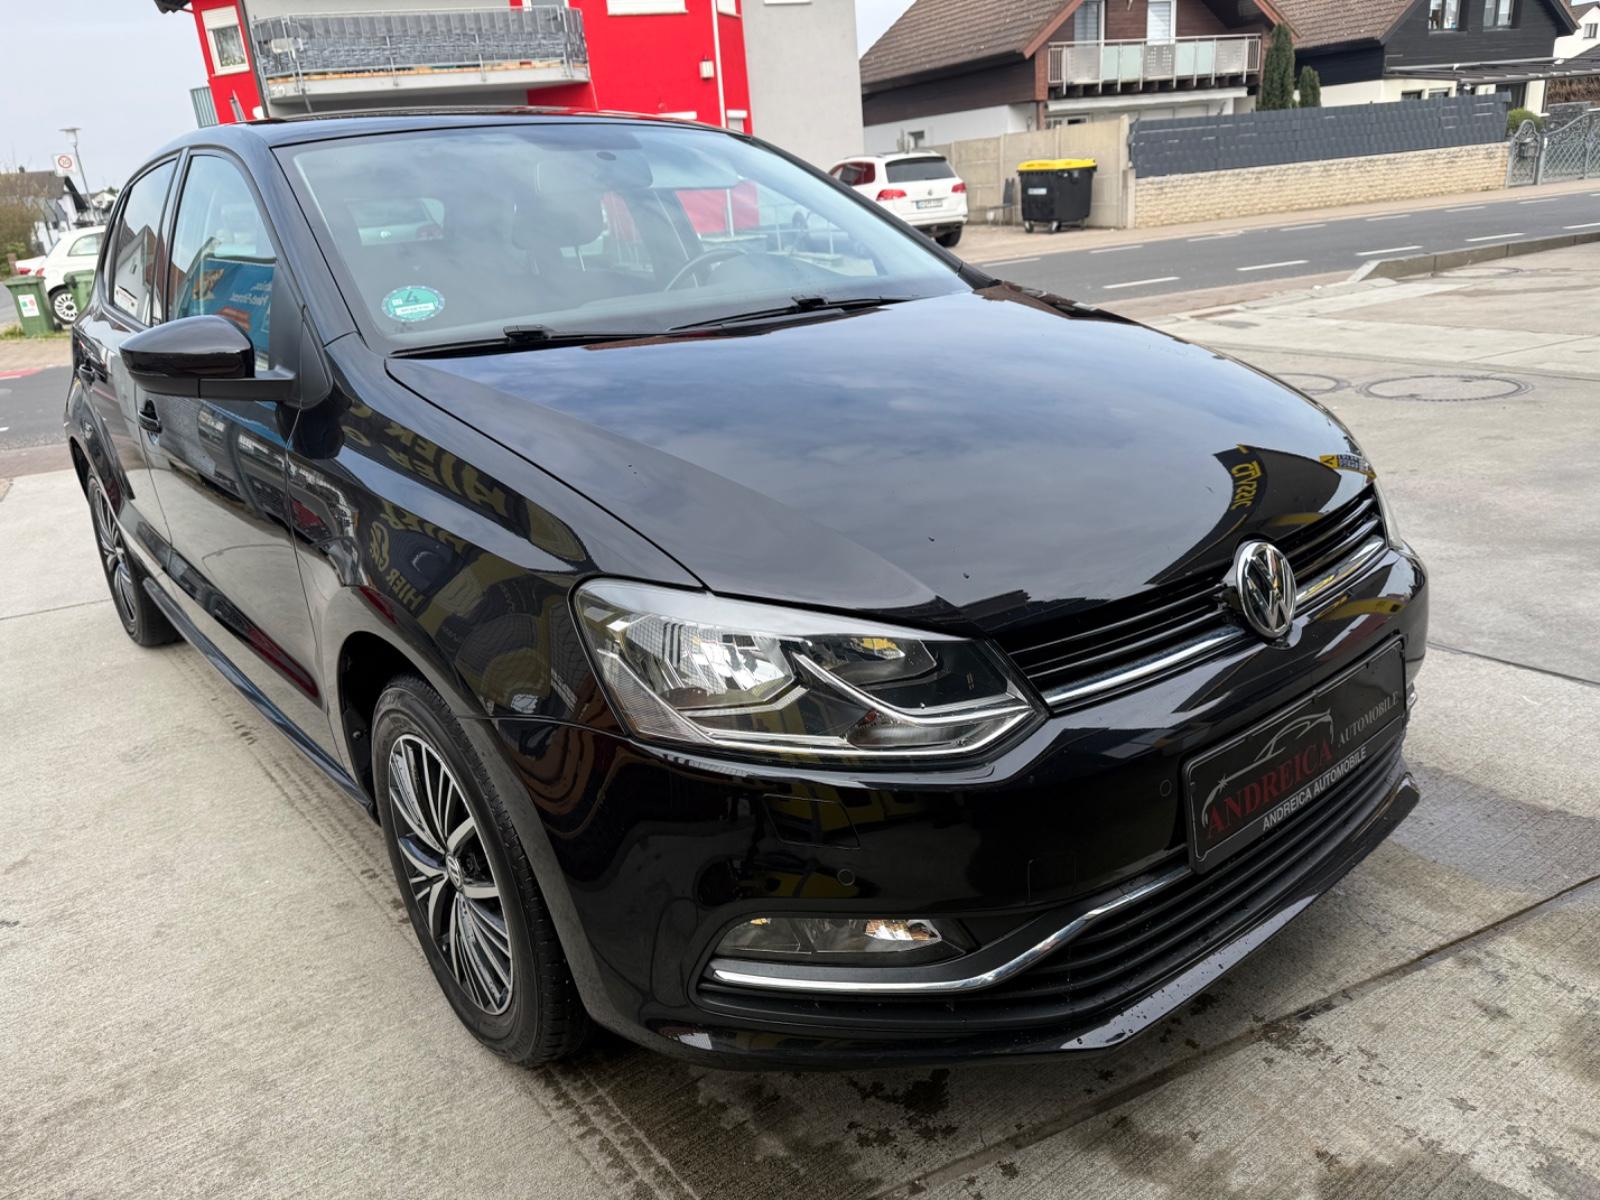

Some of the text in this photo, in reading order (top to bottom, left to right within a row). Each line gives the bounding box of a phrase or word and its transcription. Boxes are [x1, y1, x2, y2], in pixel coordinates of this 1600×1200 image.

[1207, 737, 1334, 839] ANDREICA
[1263, 746, 1367, 832] ANDREICA AUTOMOBILE
